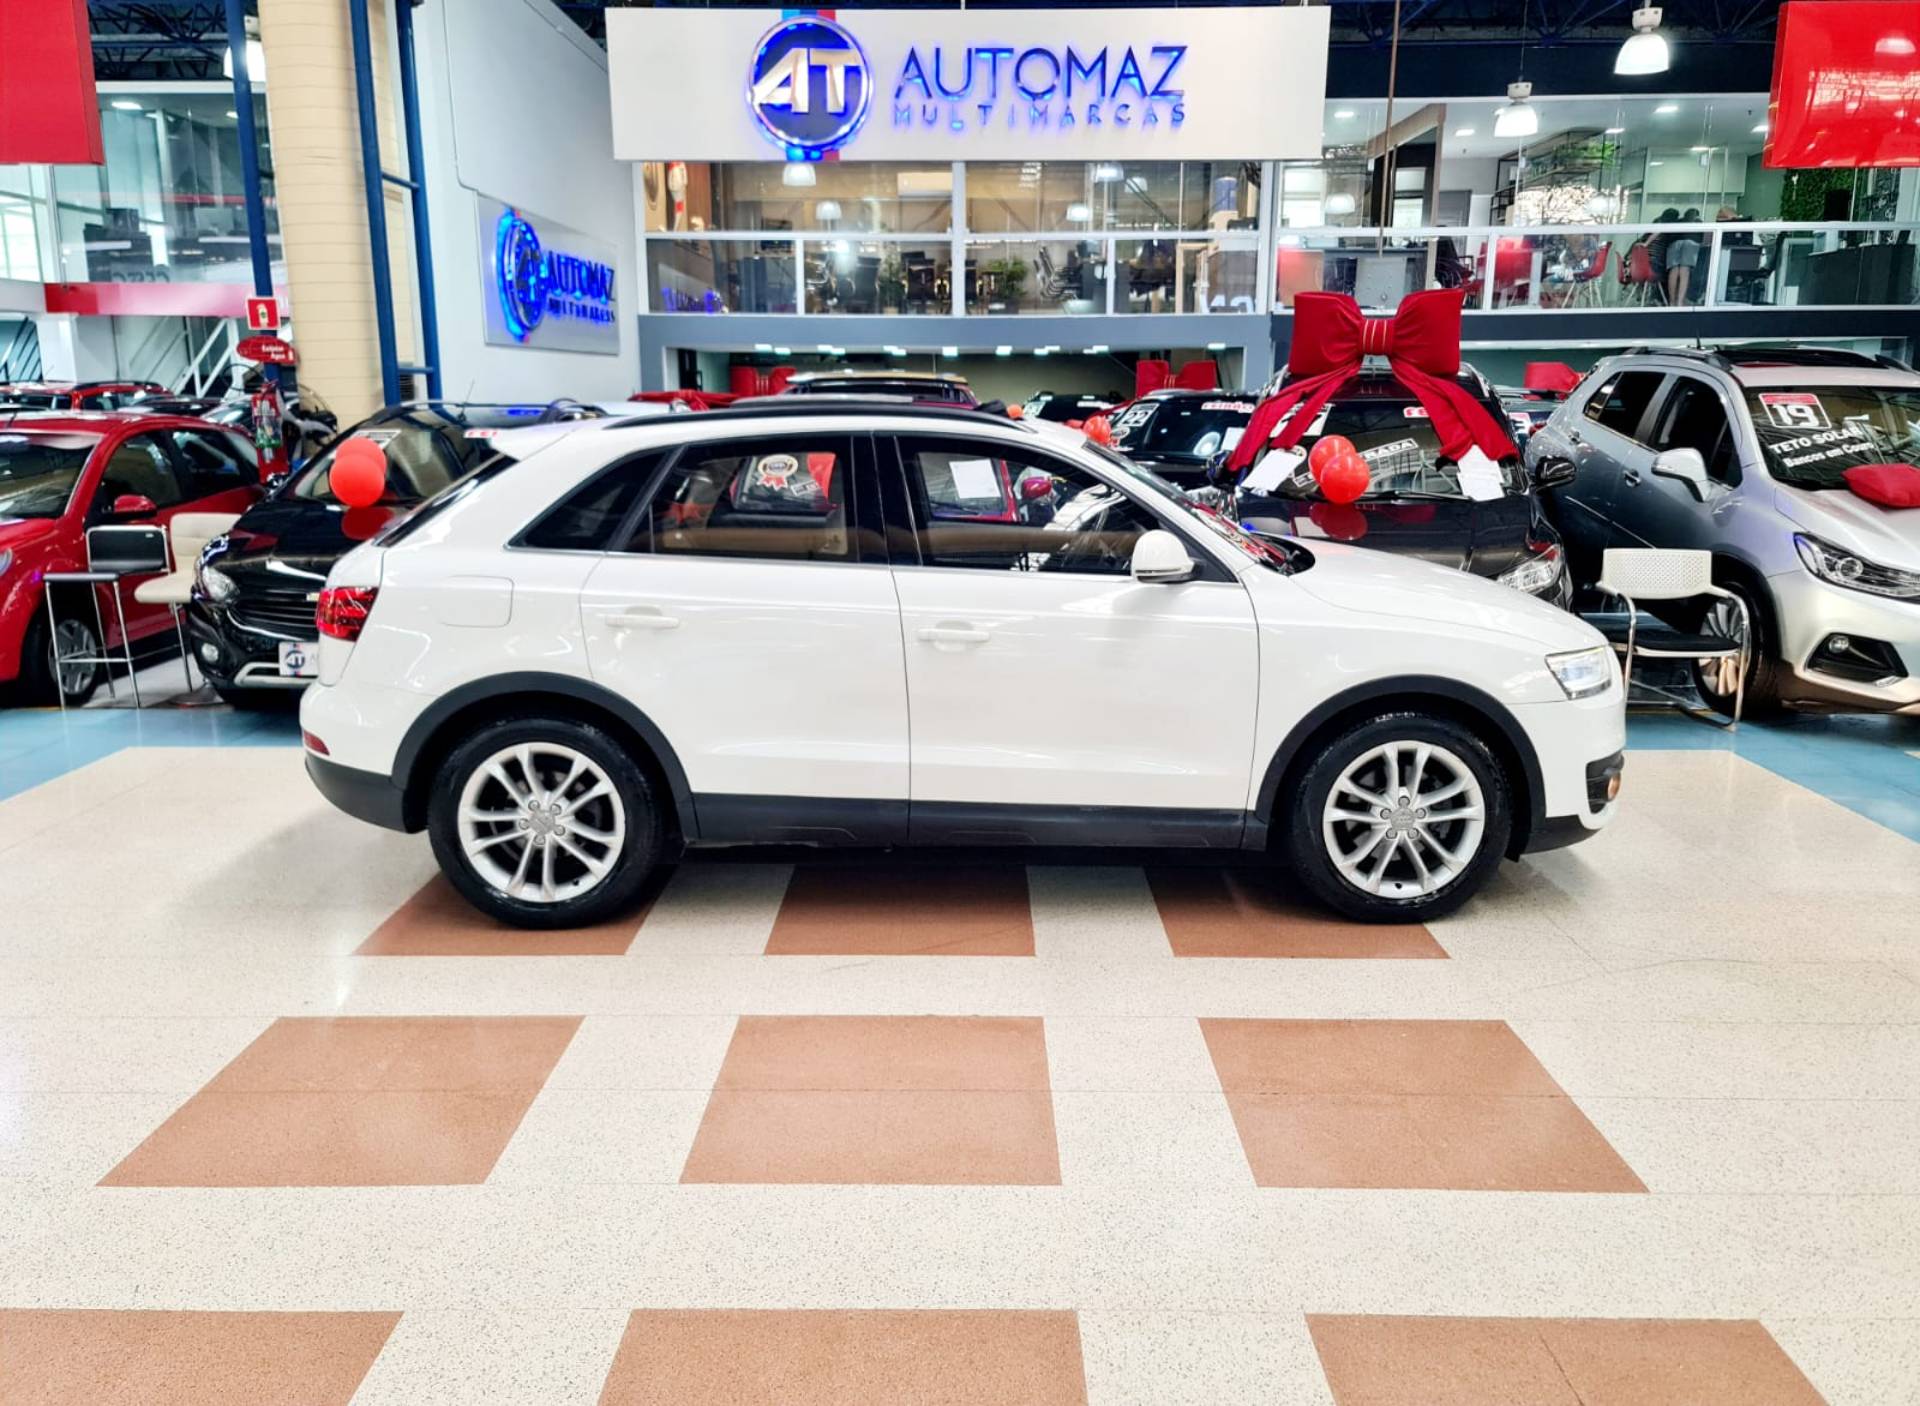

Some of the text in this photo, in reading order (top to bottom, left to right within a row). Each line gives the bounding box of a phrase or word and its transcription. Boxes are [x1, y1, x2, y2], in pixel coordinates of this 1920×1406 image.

[752, 47, 861, 114] AT
[894, 45, 1188, 101] AUTOMAZ
[894, 103, 1186, 126] MULTIMARCAS
[1122, 412, 1149, 425] 22
[1773, 404, 1820, 427] 19
[1769, 426, 1864, 454] TETO SOLAR
[1783, 453, 1826, 468] Bancos
[1826, 448, 1845, 458] em
